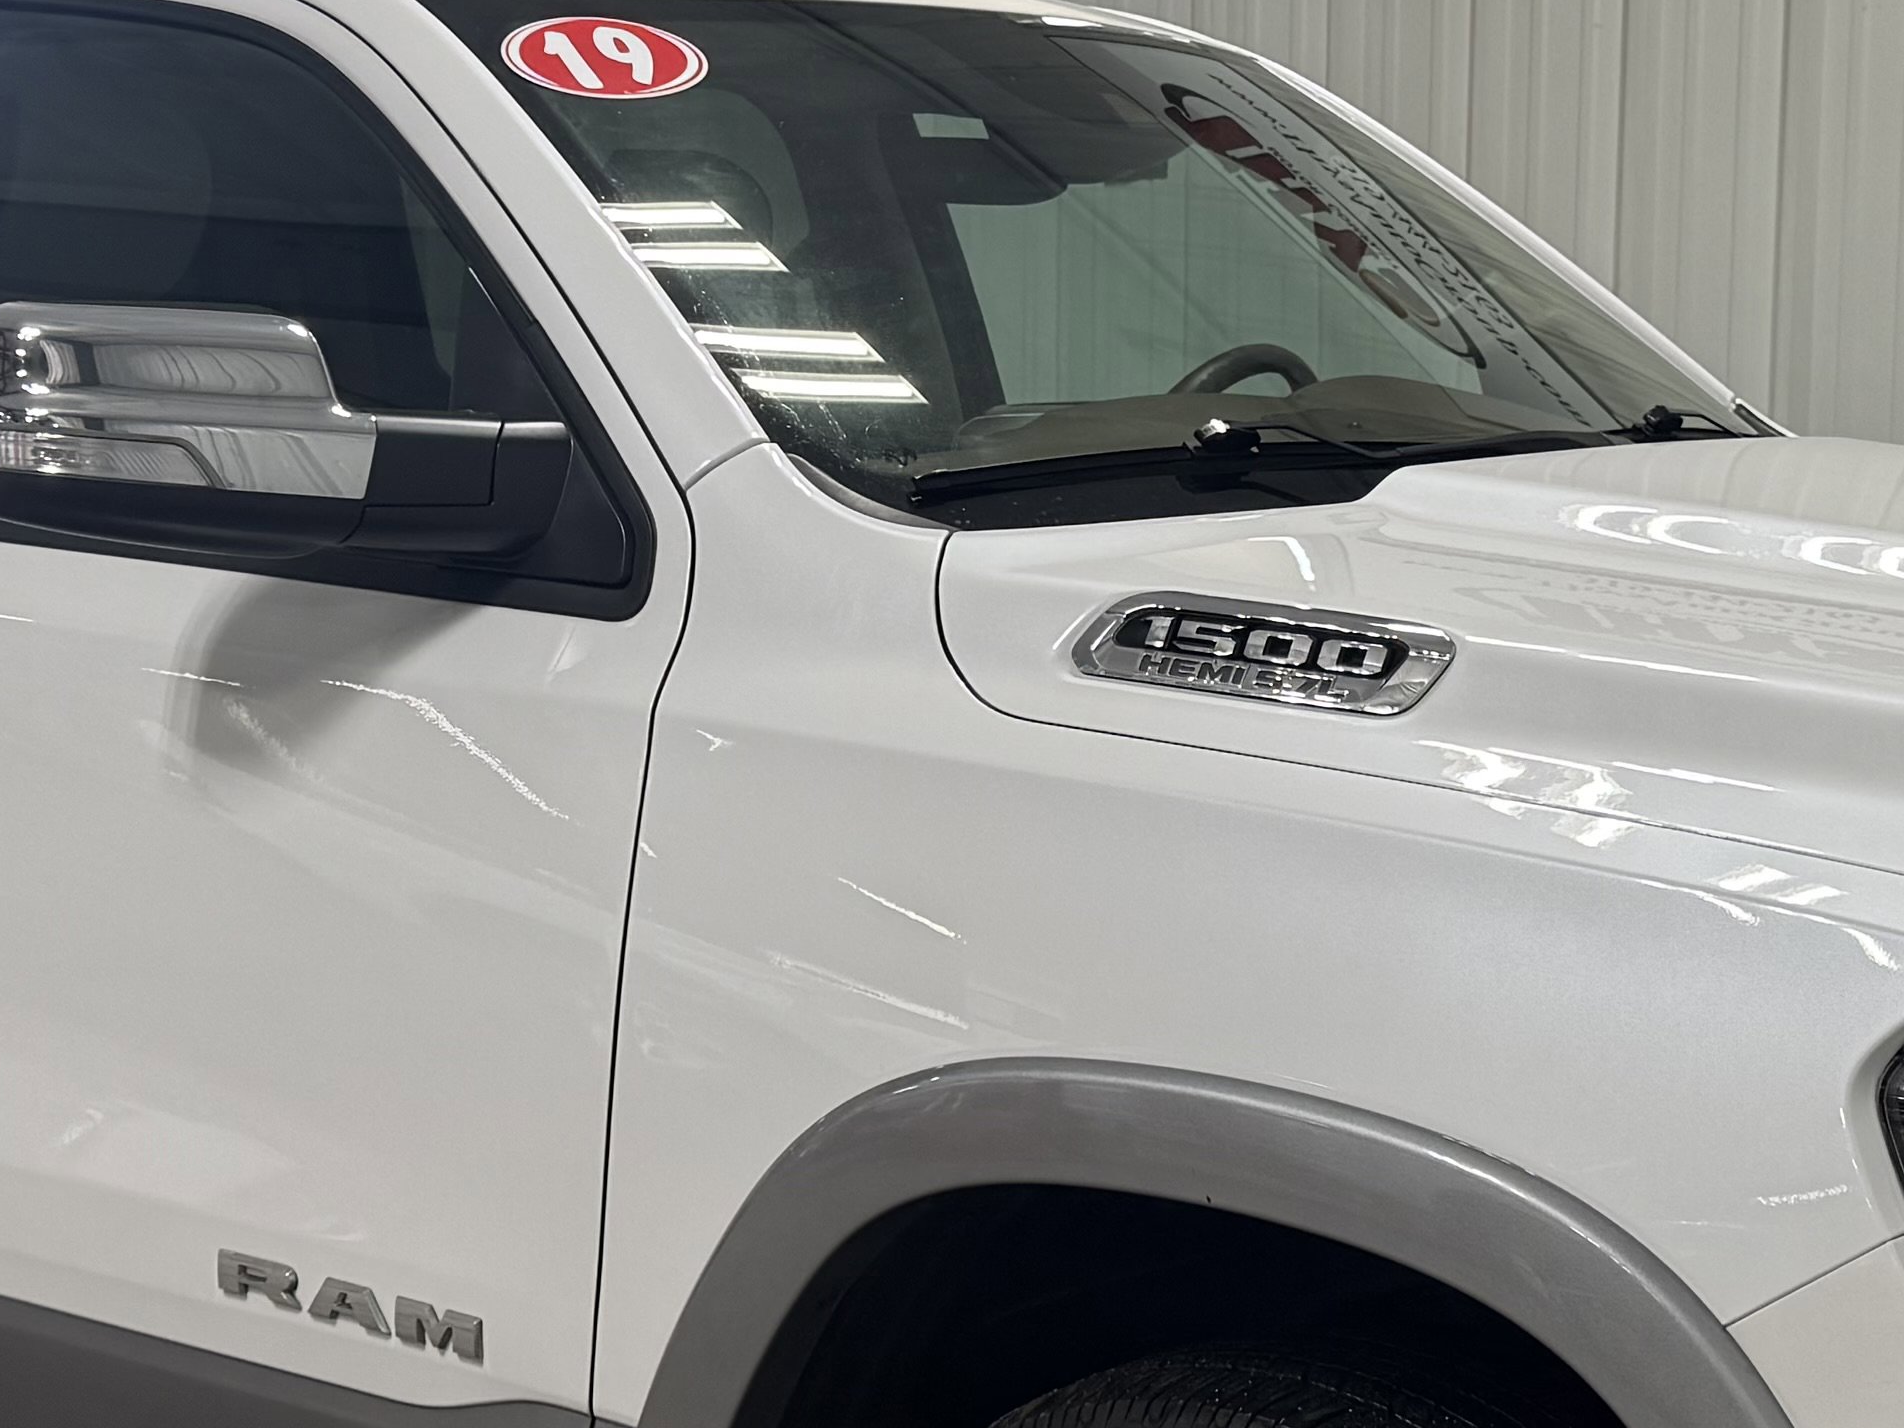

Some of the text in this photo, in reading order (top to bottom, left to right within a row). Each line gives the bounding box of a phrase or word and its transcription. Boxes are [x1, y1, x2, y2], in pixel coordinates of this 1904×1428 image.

[543, 25, 654, 90] 19
[1138, 654, 1247, 689] HEMI
[1142, 614, 1389, 676] 1500
[217, 1248, 485, 1368] RAM
